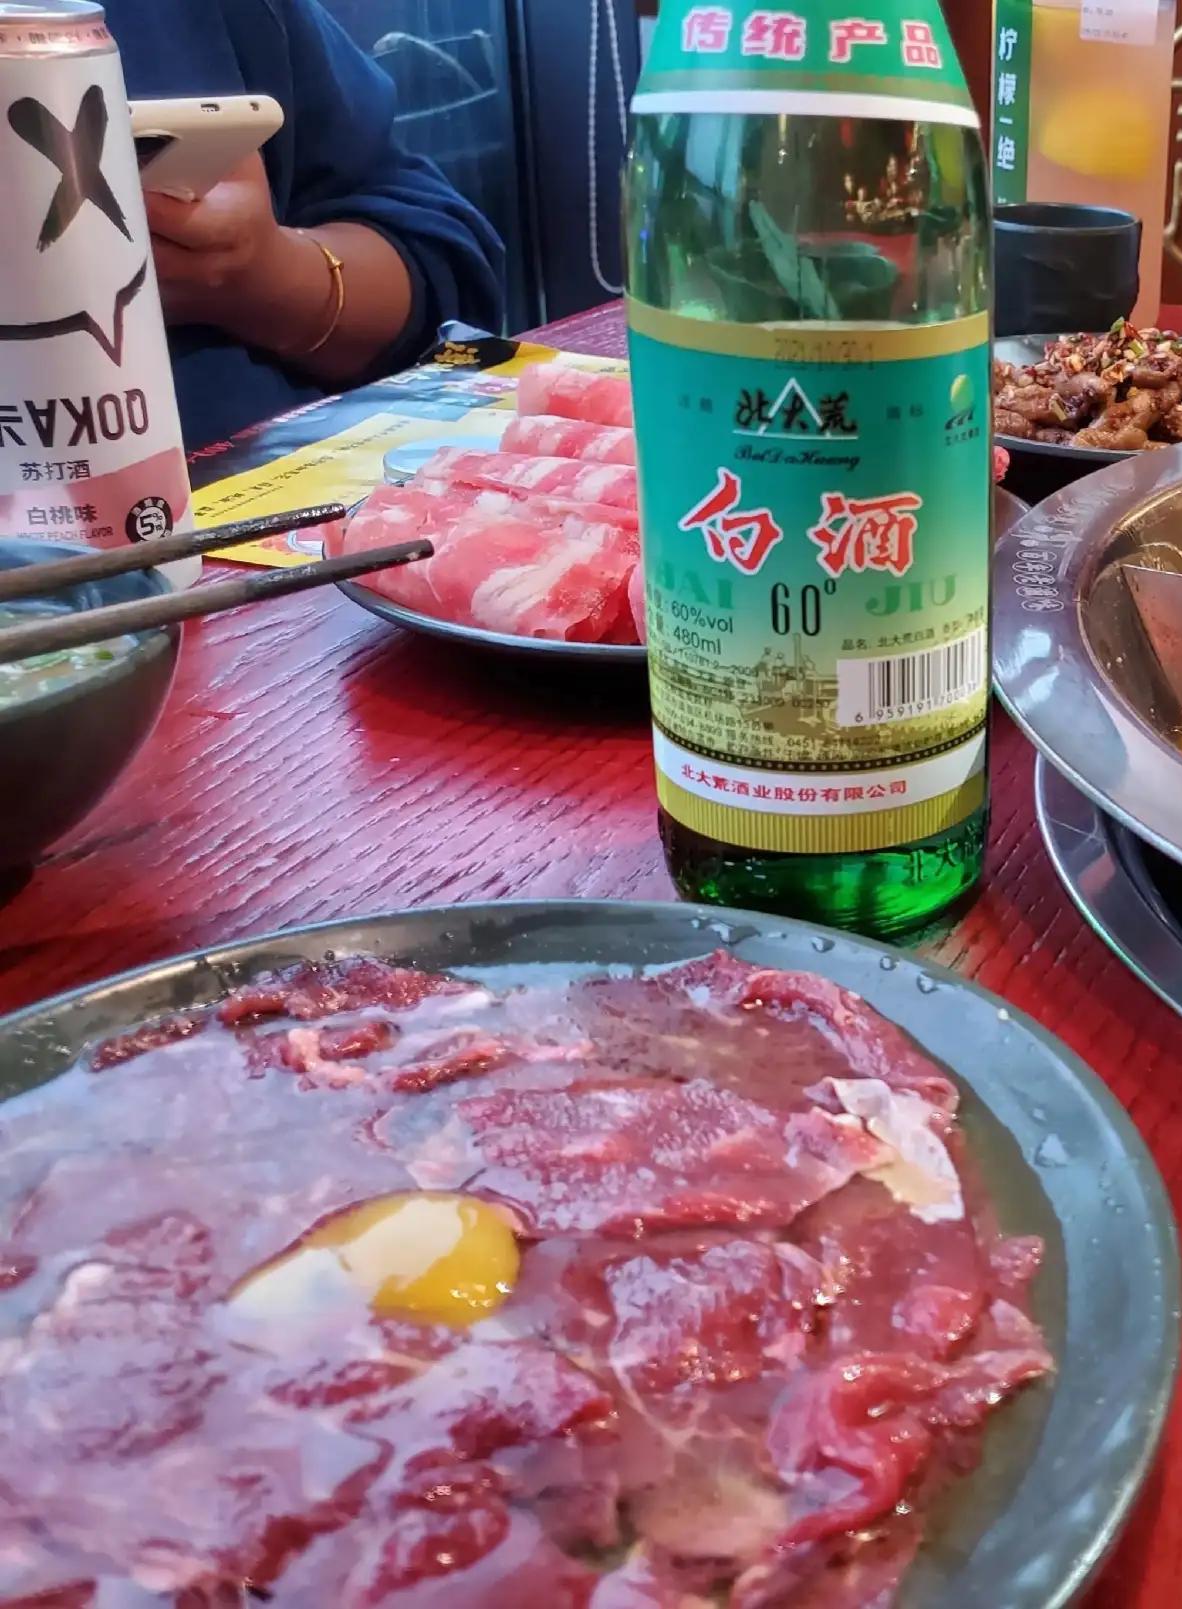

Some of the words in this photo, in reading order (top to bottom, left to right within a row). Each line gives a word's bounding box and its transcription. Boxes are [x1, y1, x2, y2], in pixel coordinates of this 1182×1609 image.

[681, 9, 943, 68] 传统产品
[19, 459, 91, 481] 苏打酒
[26, 503, 98, 525] 白桃味
[679, 467, 923, 578] 白酒
[80, 526, 114, 539] FLAVOR
[865, 574, 958, 616] JIU
[673, 625, 722, 655] 480ml
[681, 763, 908, 803] 北大荒酒业股份有限公司
